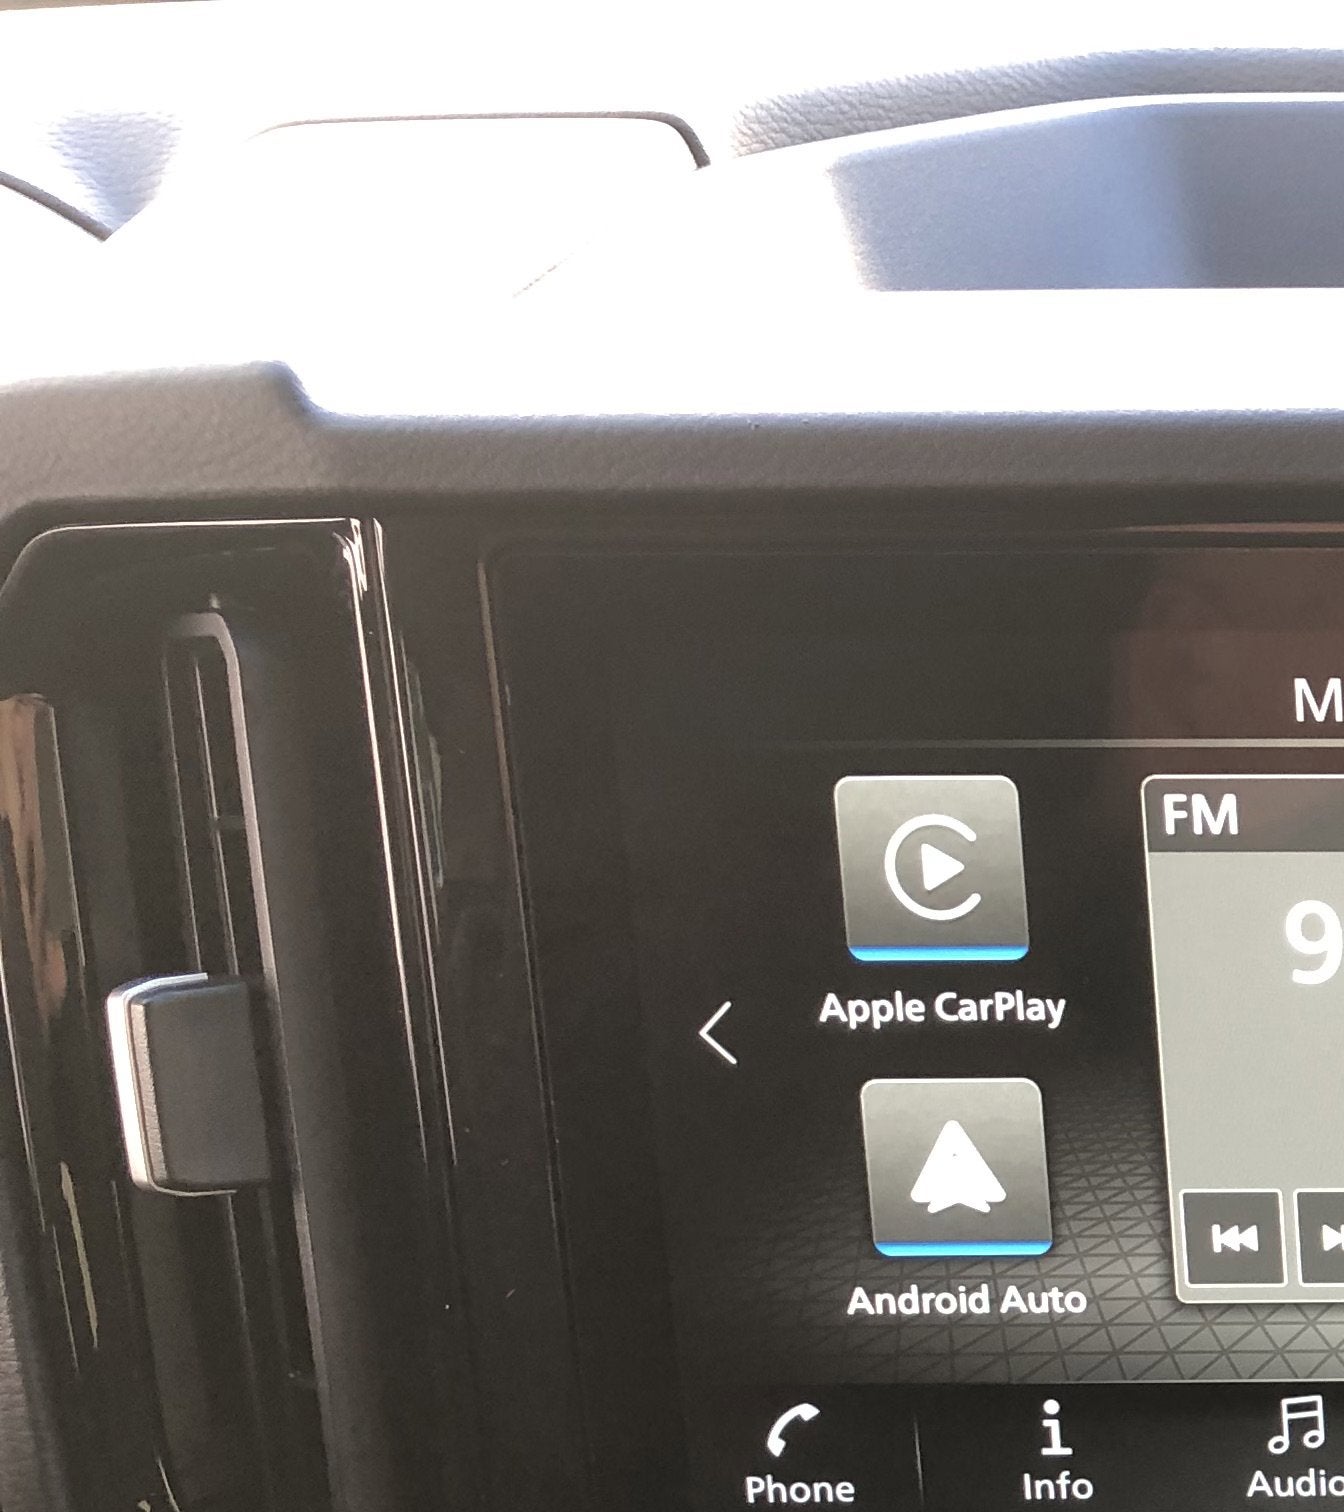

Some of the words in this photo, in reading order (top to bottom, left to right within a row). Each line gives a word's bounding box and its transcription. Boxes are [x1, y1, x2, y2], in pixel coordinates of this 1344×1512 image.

[1162, 792, 1240, 836] FM
[819, 992, 926, 1029] Apple
[934, 991, 1066, 1029] CarPlay
[846, 1285, 991, 1316] Android
[999, 1285, 1088, 1315] Auto
[744, 1475, 856, 1503] Phone
[1021, 1471, 1094, 1501] Info
